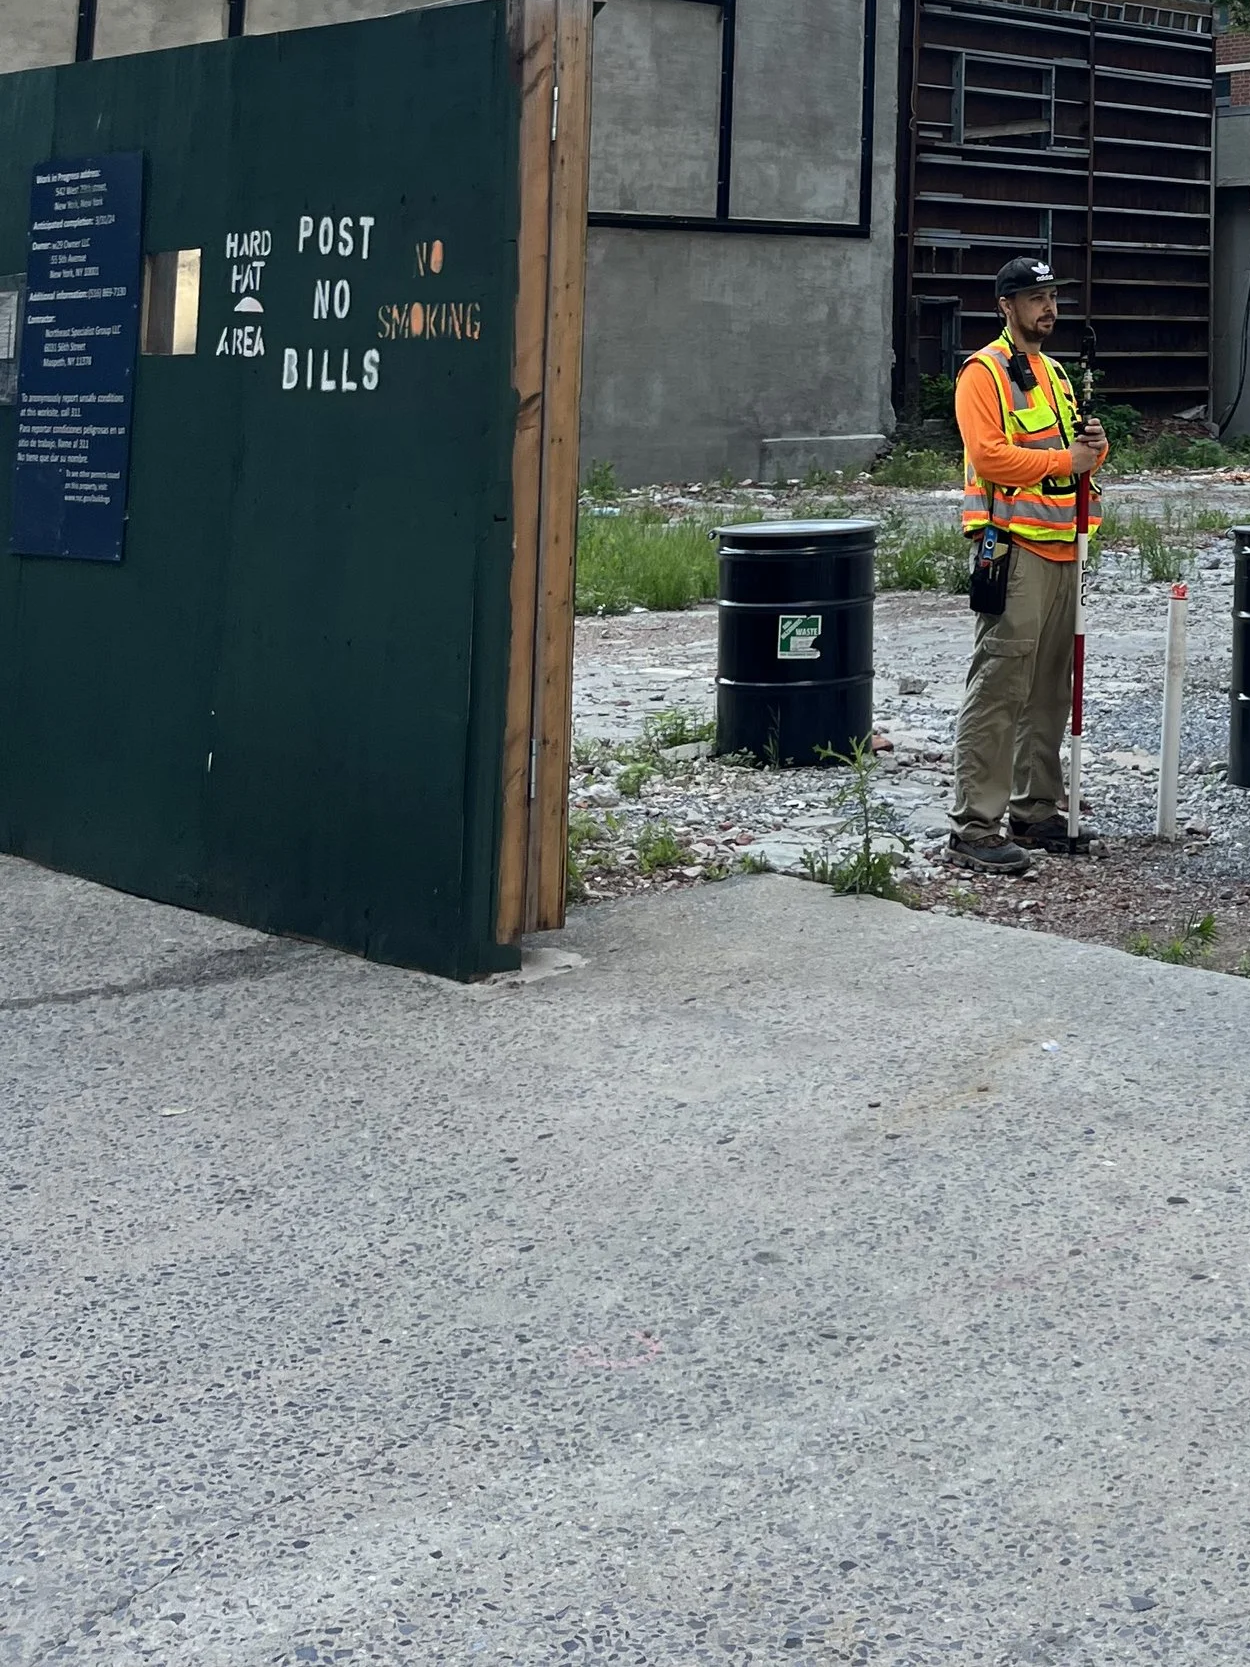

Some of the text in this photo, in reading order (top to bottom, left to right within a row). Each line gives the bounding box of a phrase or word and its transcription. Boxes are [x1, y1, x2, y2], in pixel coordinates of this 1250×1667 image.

[226, 230, 271, 259] HARD
[299, 216, 375, 259] POST
[414, 239, 444, 277] NO
[231, 261, 265, 294] HAT
[313, 279, 350, 320] NO
[378, 301, 481, 340] SMOKING
[215, 326, 265, 357] AREA
[282, 348, 380, 392] BILLS
[796, 627, 818, 636] WASTE
